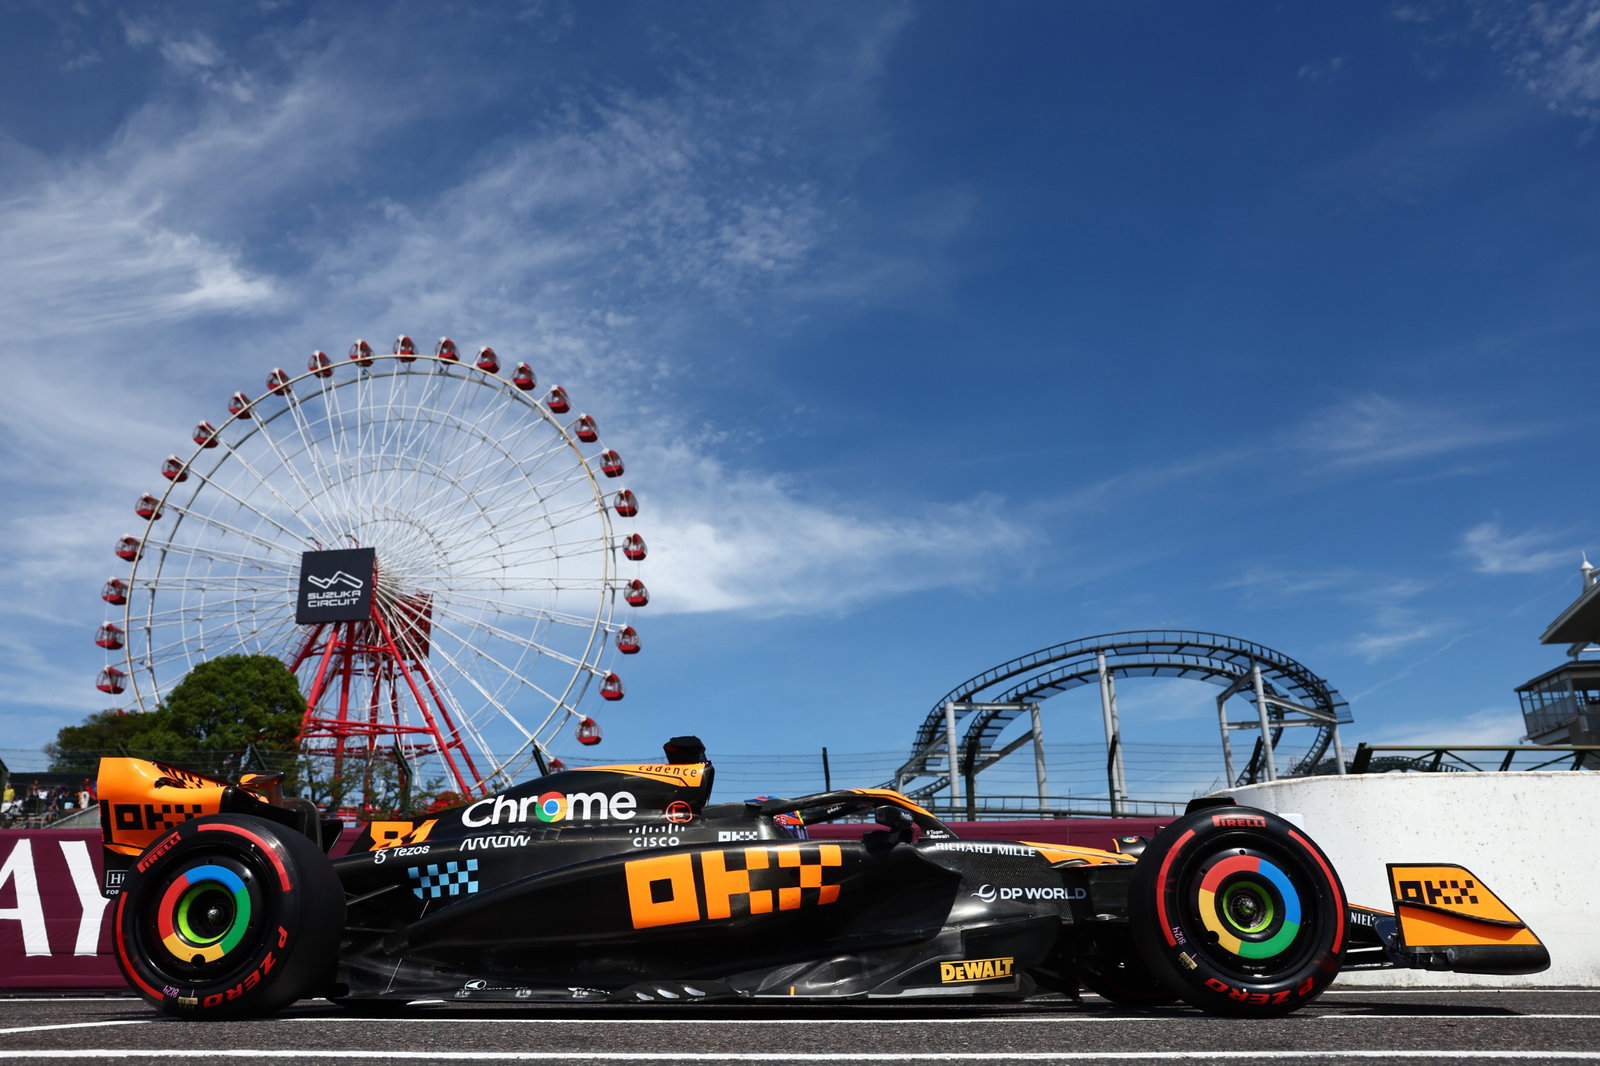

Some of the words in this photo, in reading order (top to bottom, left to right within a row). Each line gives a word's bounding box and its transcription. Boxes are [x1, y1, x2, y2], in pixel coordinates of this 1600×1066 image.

[307, 590, 361, 600] SUZUKA
[308, 598, 359, 607] CIRCUIT
[639, 764, 697, 778] cadence
[462, 791, 637, 828] Chrome
[1212, 814, 1266, 827] PIRELLI
[369, 819, 439, 851] 81
[460, 835, 530, 851] ARROW
[718, 831, 757, 842] OKX
[137, 831, 182, 873] PIRELLI
[393, 845, 430, 858] Tezos
[935, 843, 993, 854] RICHARD
[997, 847, 1036, 857] MILLE
[625, 845, 842, 929] OKX
[1000, 888, 1023, 900] DP
[1024, 888, 1087, 900] WORLD
[1399, 880, 1479, 904] OKX
[278, 925, 288, 948] P
[203, 951, 276, 1008] ZERO
[1203, 977, 1291, 1005] ZERO
